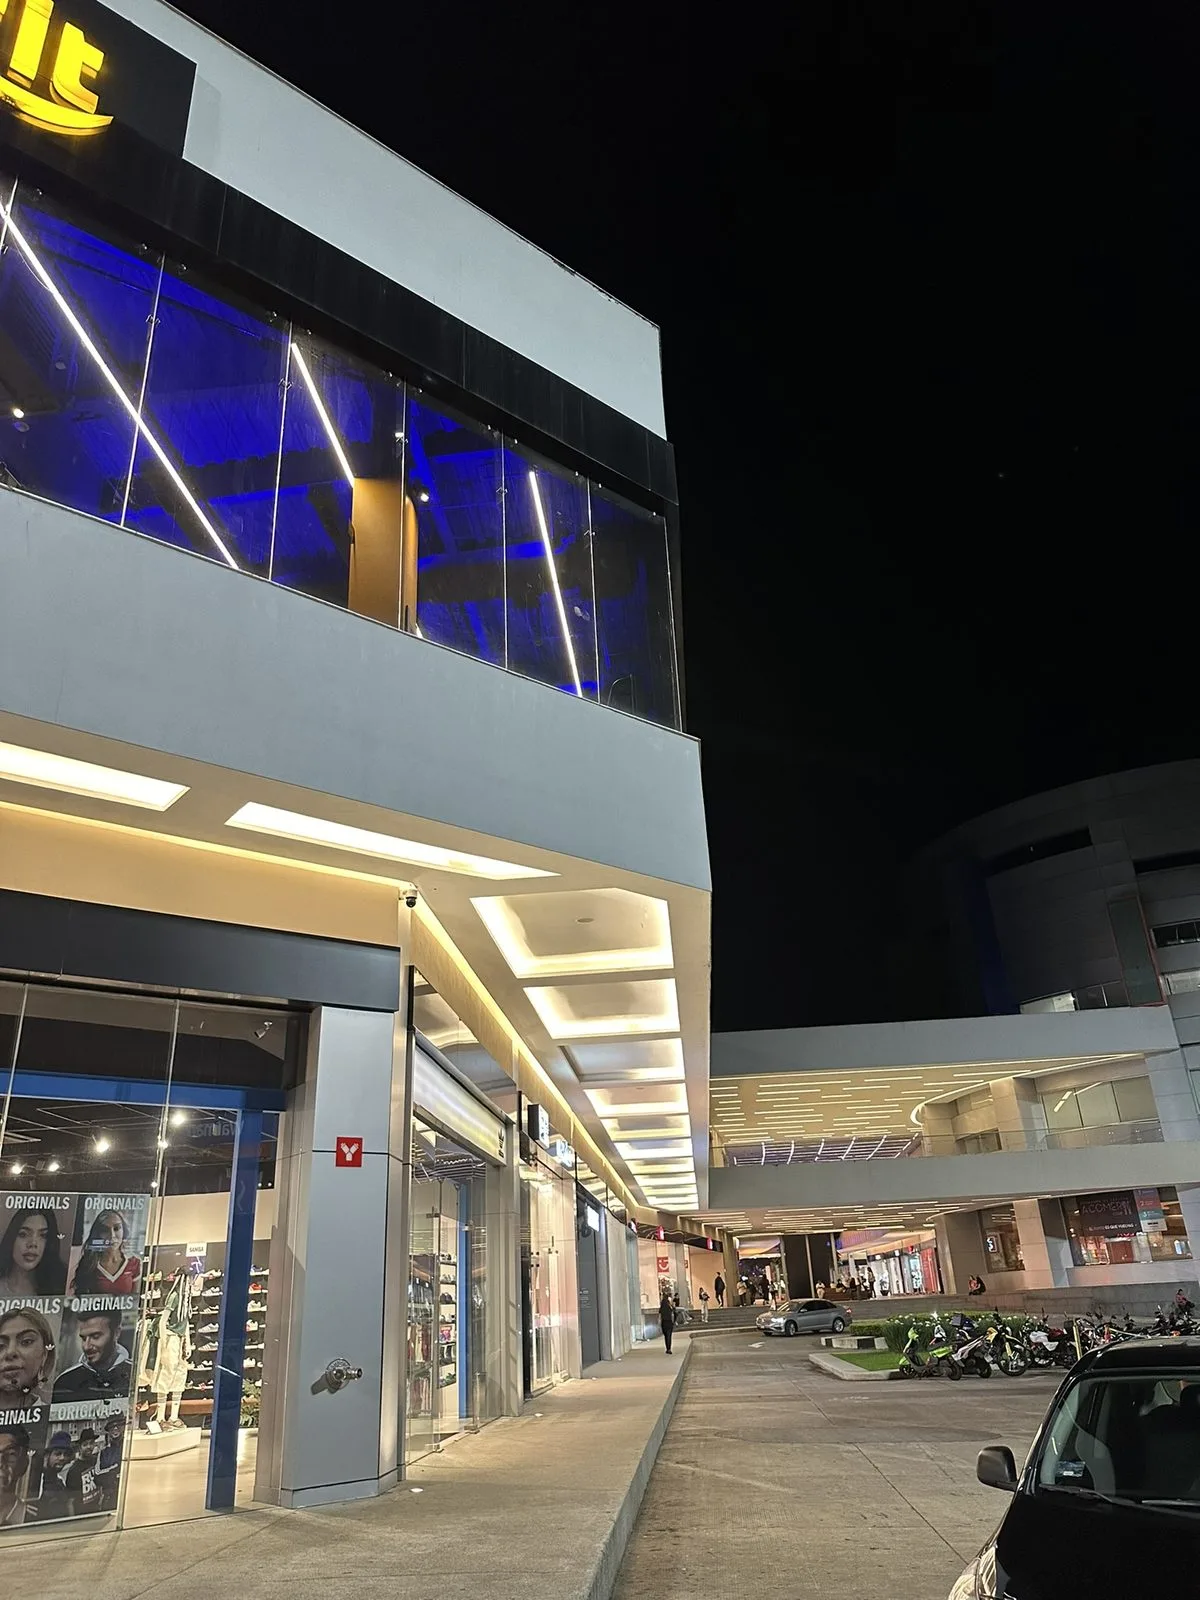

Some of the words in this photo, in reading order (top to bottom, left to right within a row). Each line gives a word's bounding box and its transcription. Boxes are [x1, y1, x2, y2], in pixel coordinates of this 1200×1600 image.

[5, 1195, 70, 1210] ORIGINALS
[84, 1197, 144, 1210] ORIGINALS
[0, 1298, 61, 1316] RIGINALS
[71, 1296, 133, 1312] ORIGINALS
[0, 1407, 42, 1426] GINALS
[58, 1401, 121, 1420] ORIGINALS
